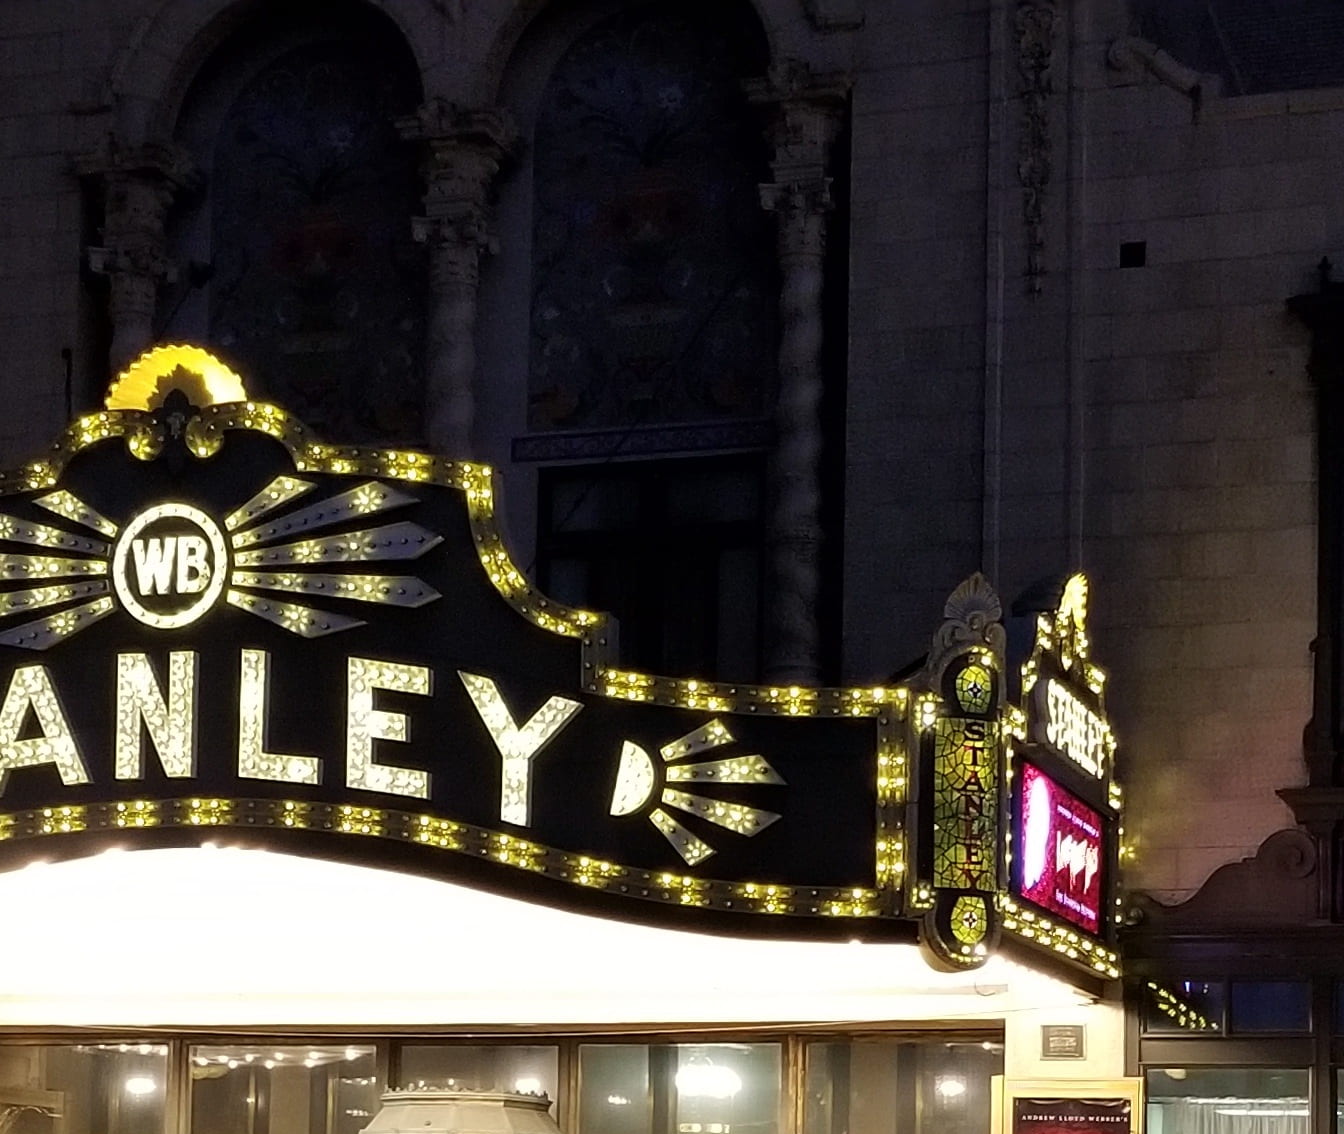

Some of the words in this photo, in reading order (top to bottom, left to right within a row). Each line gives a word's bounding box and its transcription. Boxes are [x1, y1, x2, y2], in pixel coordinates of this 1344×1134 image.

[132, 535, 210, 596] WB
[1047, 678, 1110, 780] STANLEY
[963, 722, 986, 889] STANLEY
